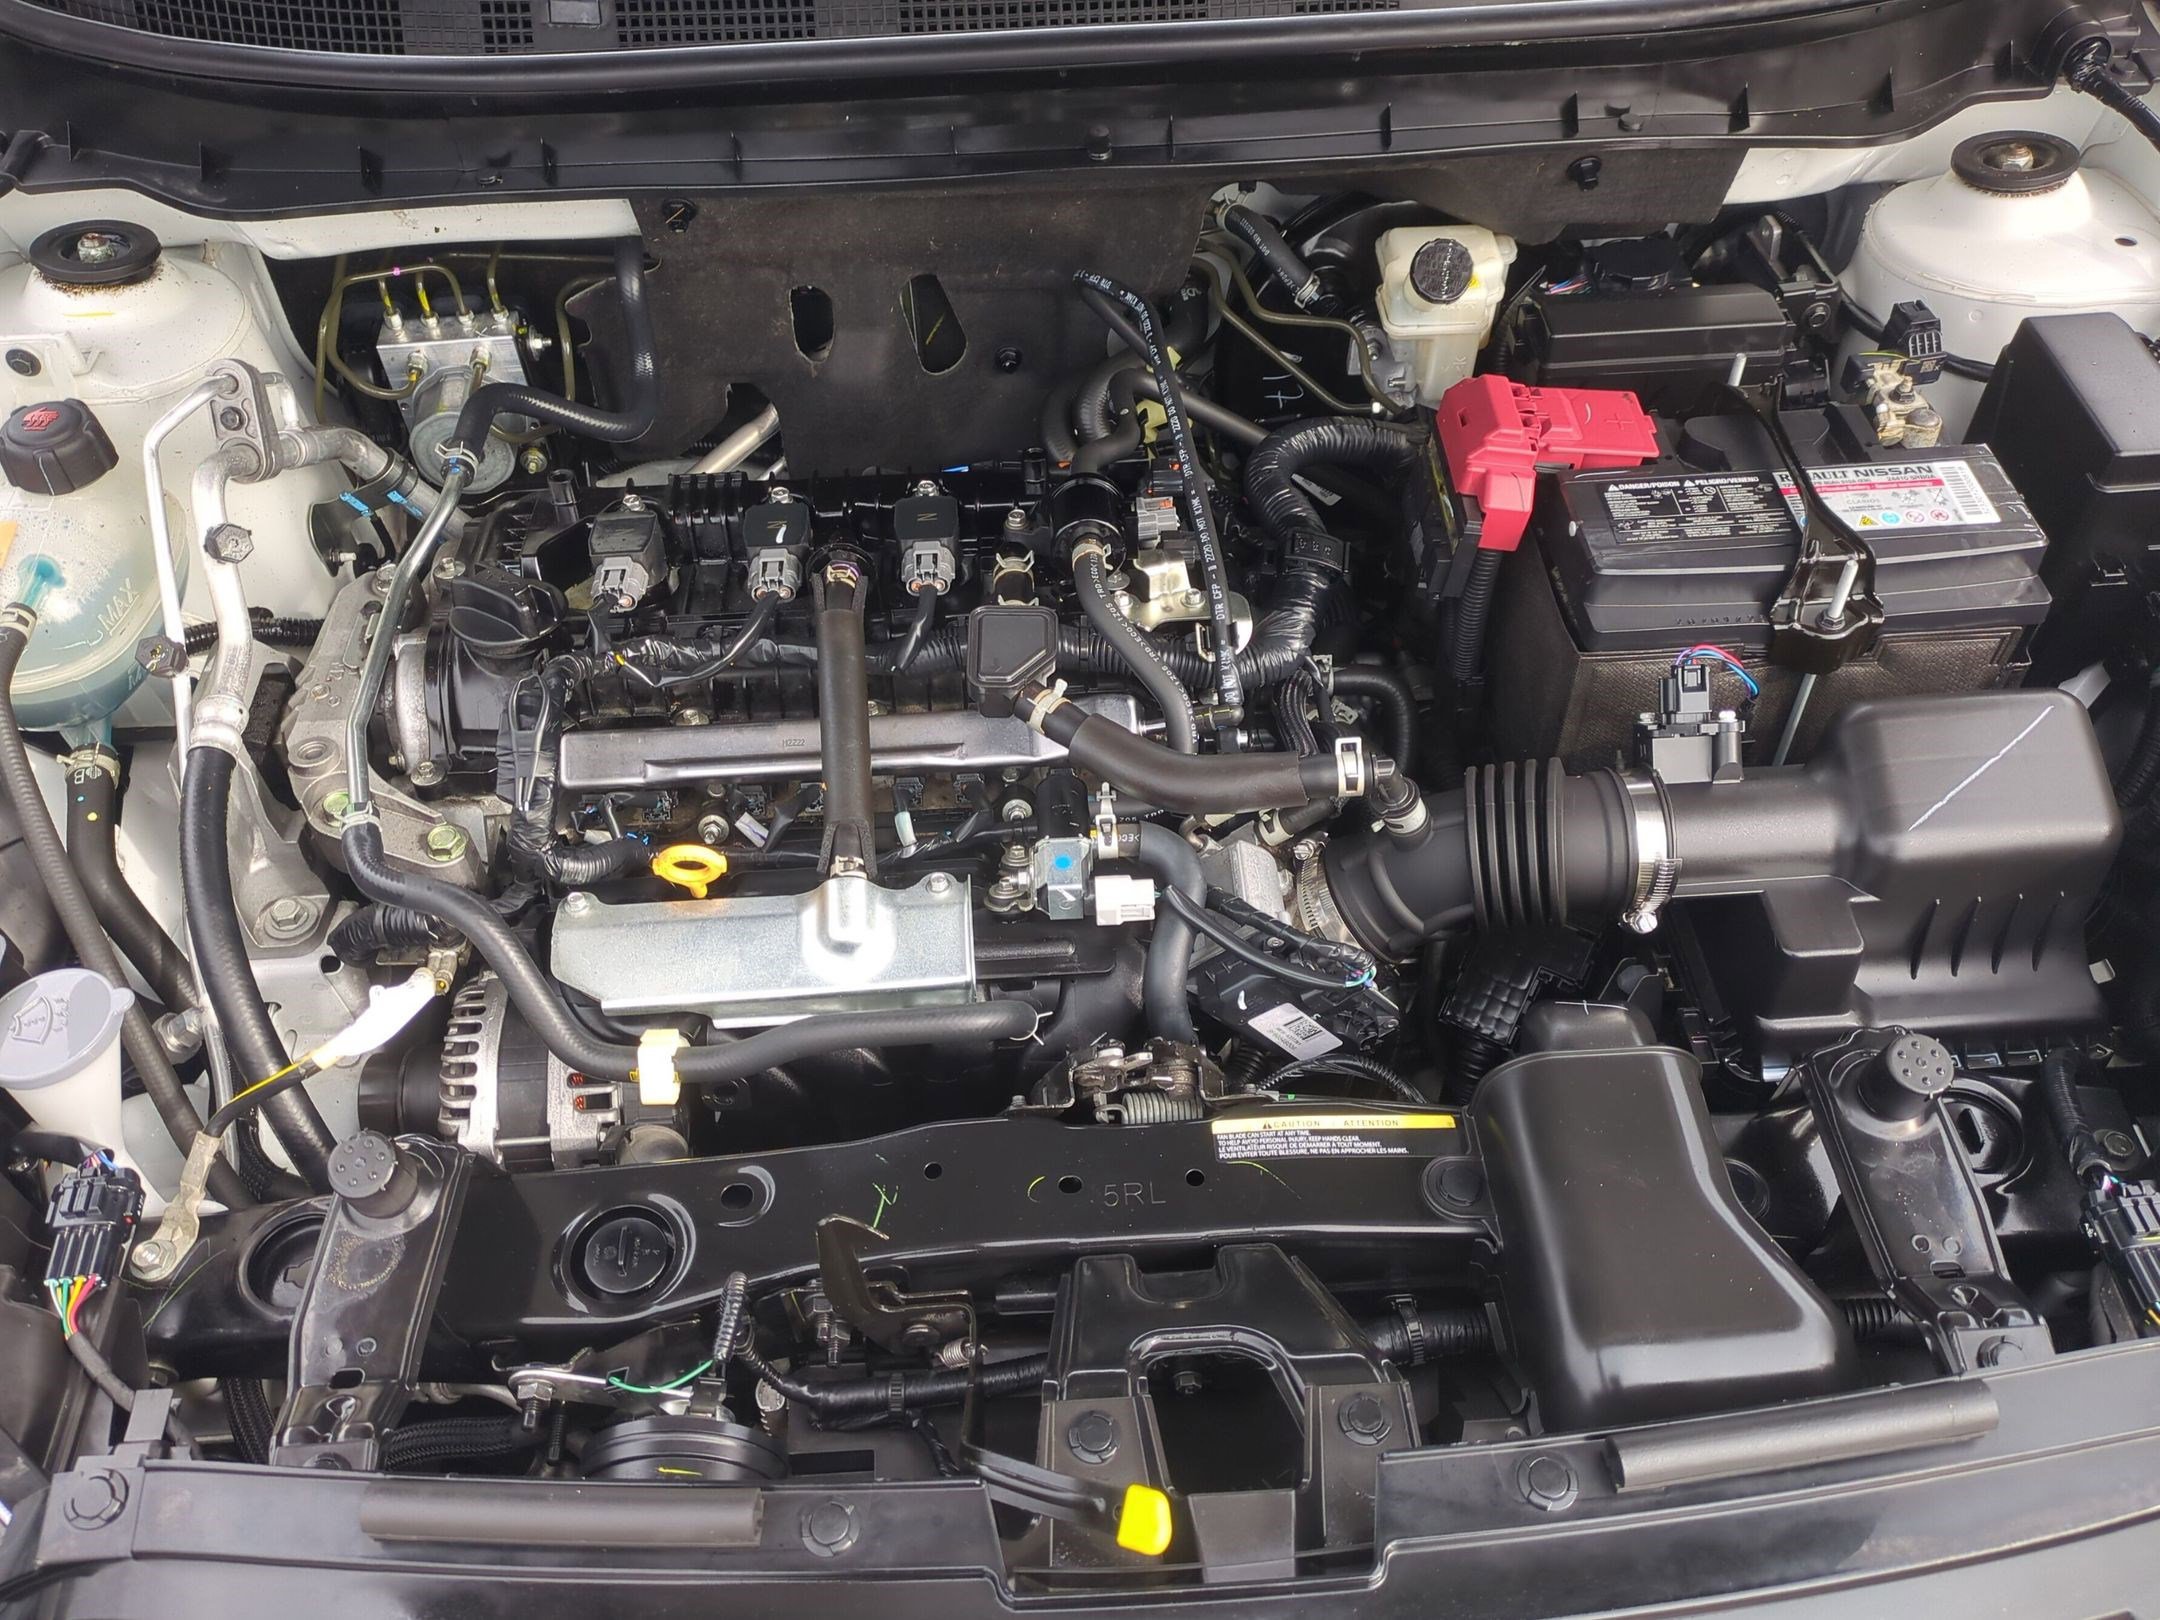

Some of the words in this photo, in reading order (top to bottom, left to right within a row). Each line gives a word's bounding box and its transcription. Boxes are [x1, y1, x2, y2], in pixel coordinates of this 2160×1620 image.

[1779, 469, 1850, 483] RAULT
[1854, 465, 1934, 478] NISSAN
[1618, 480, 1681, 491] DANGER/POISON
[1694, 476, 1760, 487] PELIGRO/VENENO
[1191, 496, 1204, 516] KINK
[1195, 517, 1208, 531] NOT
[1199, 532, 1211, 543] DO
[1202, 544, 1216, 563] 2220
[1211, 583, 1223, 600] CFP
[97, 577, 135, 631] MAX
[1214, 602, 1225, 621] DTR
[1273, 1120, 1320, 1129] CAUTION
[1343, 1119, 1399, 1127] ATTENTION
[1227, 1144, 1266, 1152] VENTILATEUR
[1258, 1149, 1278, 1157] TOUTE
[1104, 1181, 1167, 1207] 5RL
